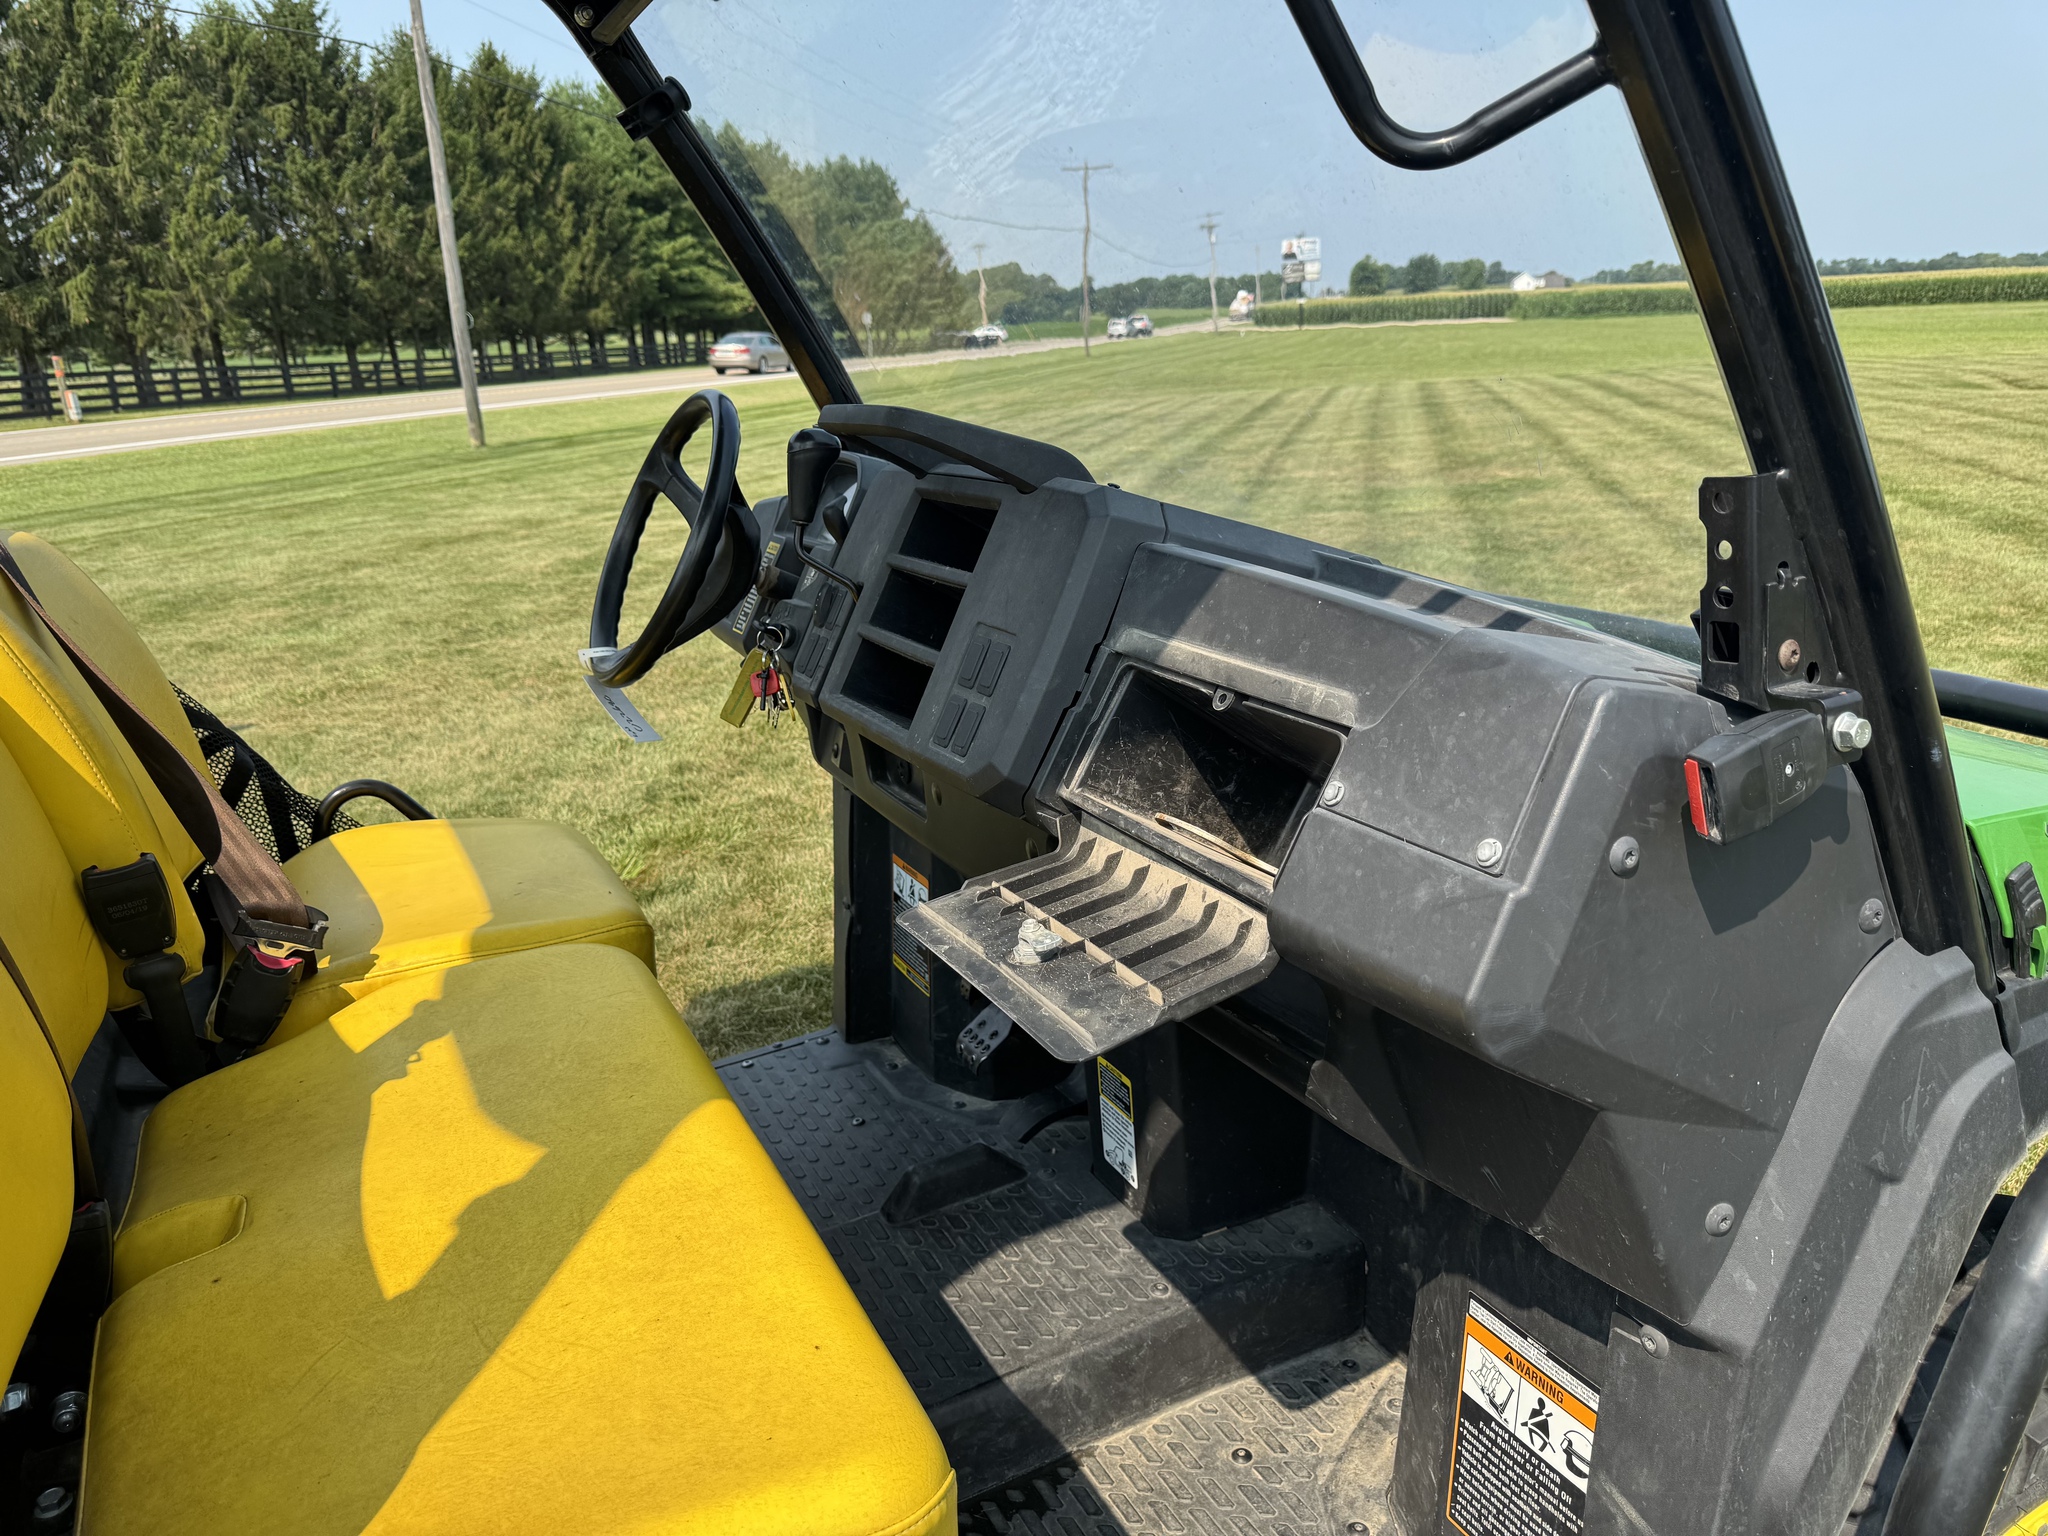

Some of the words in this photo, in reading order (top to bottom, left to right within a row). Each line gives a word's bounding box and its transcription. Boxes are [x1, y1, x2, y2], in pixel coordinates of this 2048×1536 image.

[1516, 1358, 1564, 1404] WARNING
[1479, 1421, 1496, 1440] From
[1496, 1436, 1525, 1464] Rollover
[1525, 1462, 1533, 1472] or
[1534, 1468, 1559, 1496] Falling
[1561, 1491, 1572, 1505] Off
[1490, 1421, 1509, 1441] Avoid
[1510, 1437, 1530, 1459] Injury
[1531, 1456, 1539, 1466] or
[1540, 1462, 1561, 1485] Death
